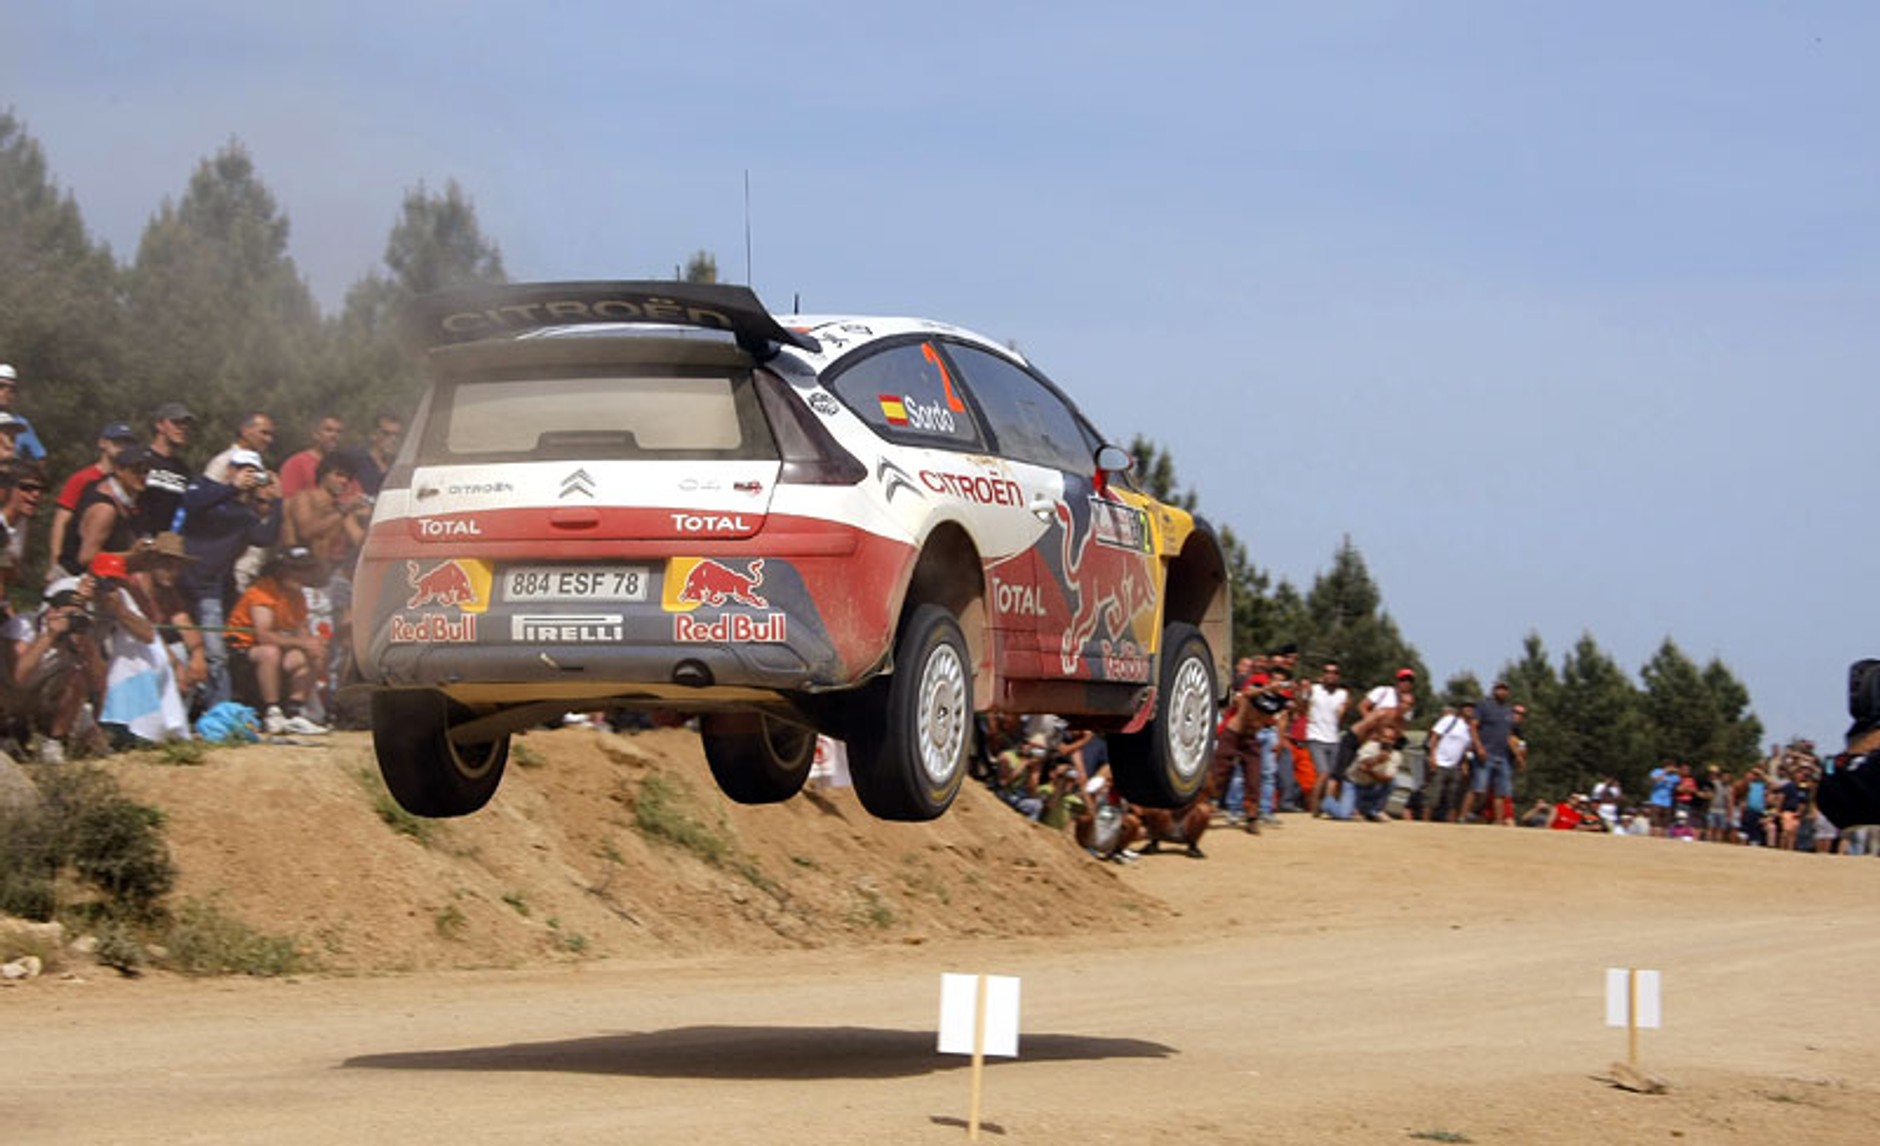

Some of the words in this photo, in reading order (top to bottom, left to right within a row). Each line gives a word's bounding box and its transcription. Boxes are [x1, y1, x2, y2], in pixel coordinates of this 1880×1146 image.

[904, 395, 955, 432] Sordo
[919, 470, 1023, 507] CITROËN
[418, 518, 482, 535] TOTAL
[670, 514, 751, 532] TOTAL
[512, 573, 549, 595] 884
[559, 573, 605, 594] ESF
[613, 573, 639, 595] 78
[991, 577, 1047, 616] TOTAL
[392, 614, 430, 641] Red
[431, 613, 476, 642] Bull
[511, 614, 624, 641] PIRELLI
[675, 613, 730, 642] Red
[731, 613, 785, 642] Bull
